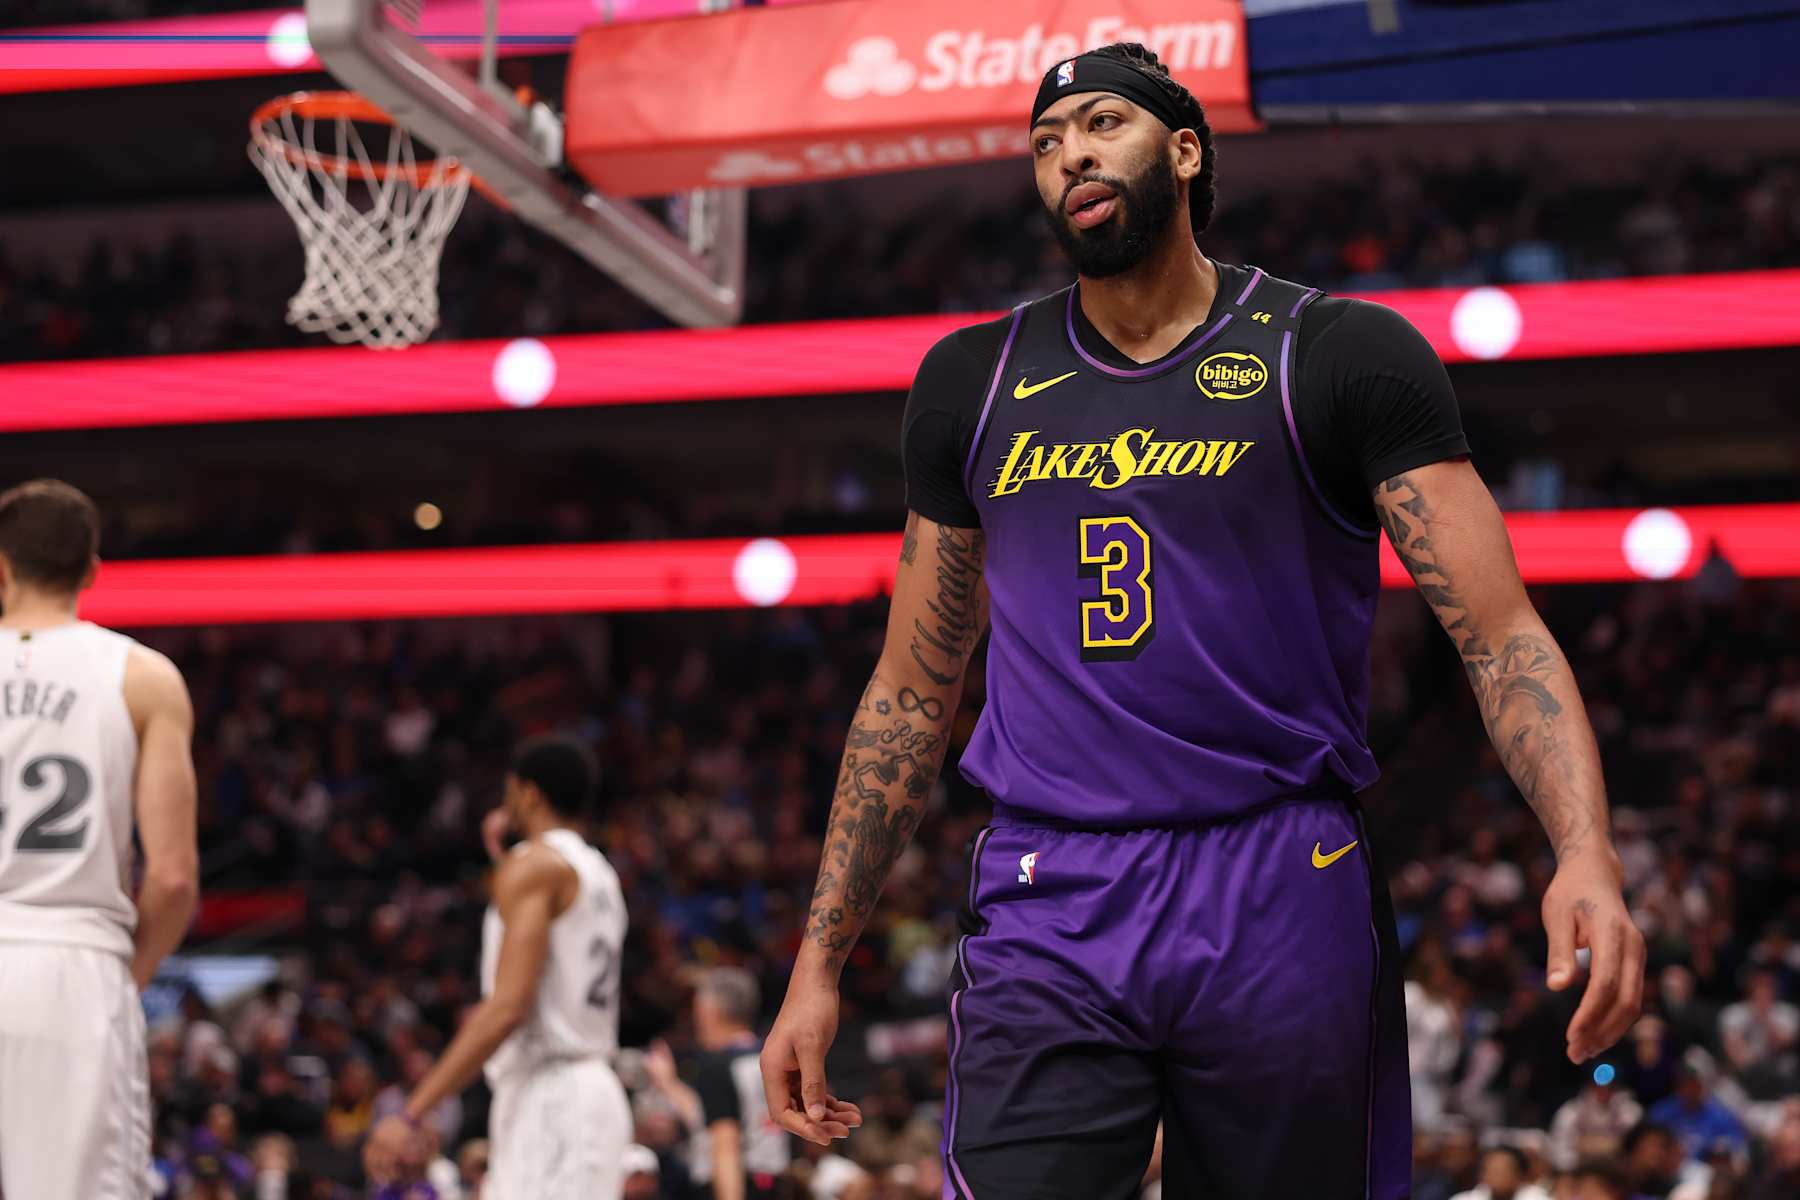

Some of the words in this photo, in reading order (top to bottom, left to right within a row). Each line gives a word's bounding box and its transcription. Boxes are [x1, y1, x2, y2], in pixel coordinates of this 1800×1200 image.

[1251, 312, 1272, 325] 44
[1203, 364, 1264, 386] bibigo
[1212, 380, 1238, 389] 비비고
[1079, 516, 1154, 650] 3
[0, 754, 93, 853] 2
